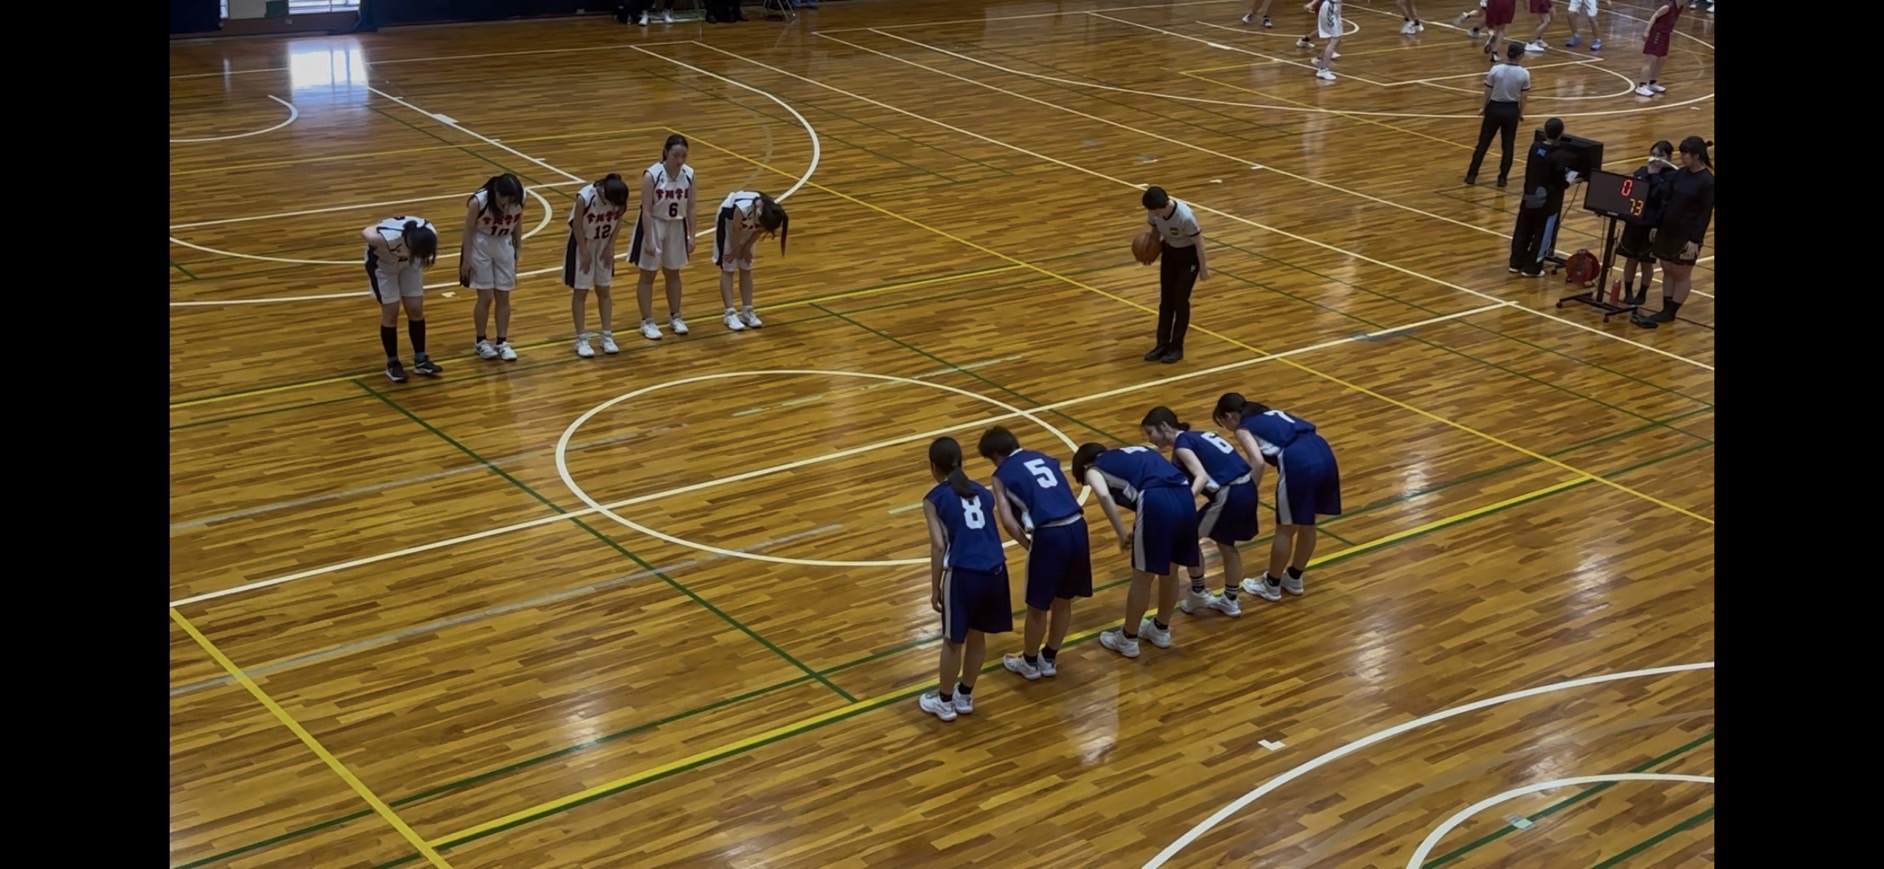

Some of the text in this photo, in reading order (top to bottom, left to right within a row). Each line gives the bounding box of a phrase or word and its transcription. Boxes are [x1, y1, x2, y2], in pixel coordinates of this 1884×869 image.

[1620, 179, 1633, 197] 0
[668, 202, 679, 218] 6
[1629, 198, 1645, 216] 73
[593, 224, 612, 240] 12
[1200, 431, 1234, 455] 6
[1023, 458, 1059, 489] 5
[960, 495, 986, 530] 8
